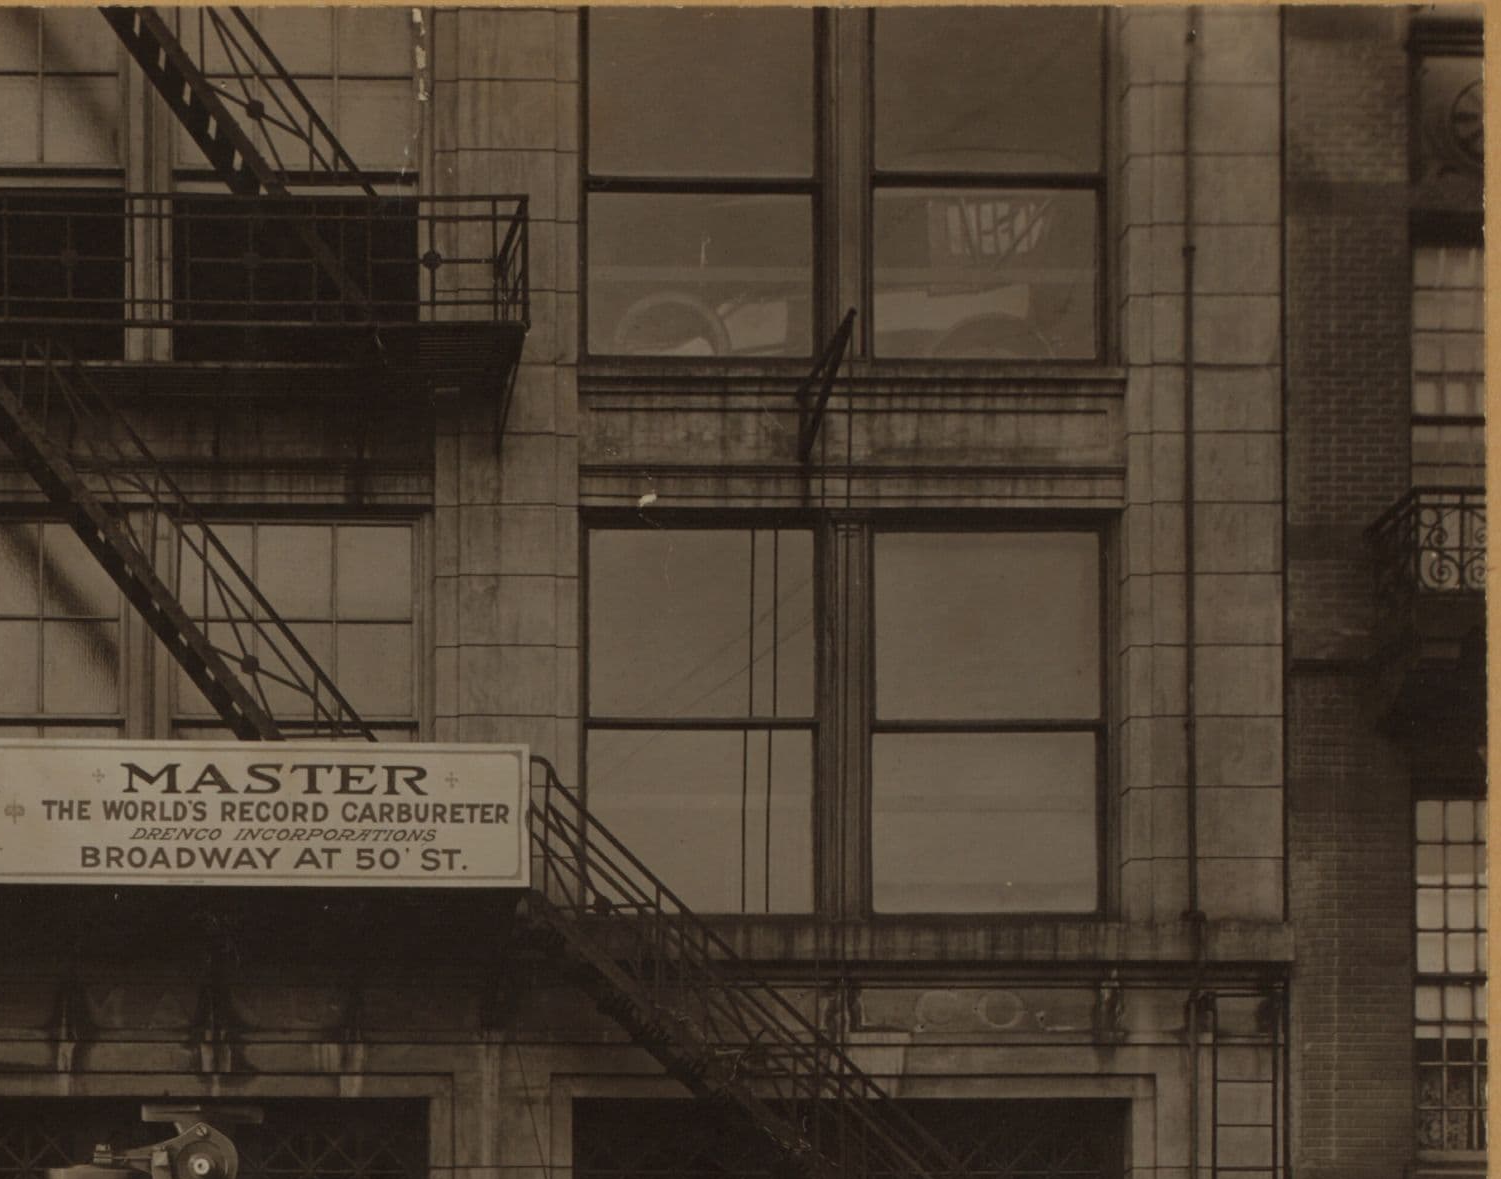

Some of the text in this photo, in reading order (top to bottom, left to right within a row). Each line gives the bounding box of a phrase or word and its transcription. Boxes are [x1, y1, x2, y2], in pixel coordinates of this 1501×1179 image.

[120, 761, 429, 796] MASTER
[43, 799, 510, 825] THE WORLD'S RECORD CARBURETER
[129, 828, 437, 843] DRENCO INCORPORATIONS
[80, 846, 282, 870] BROADWAY
[293, 847, 342, 870] AT
[419, 848, 469, 871] ST.
